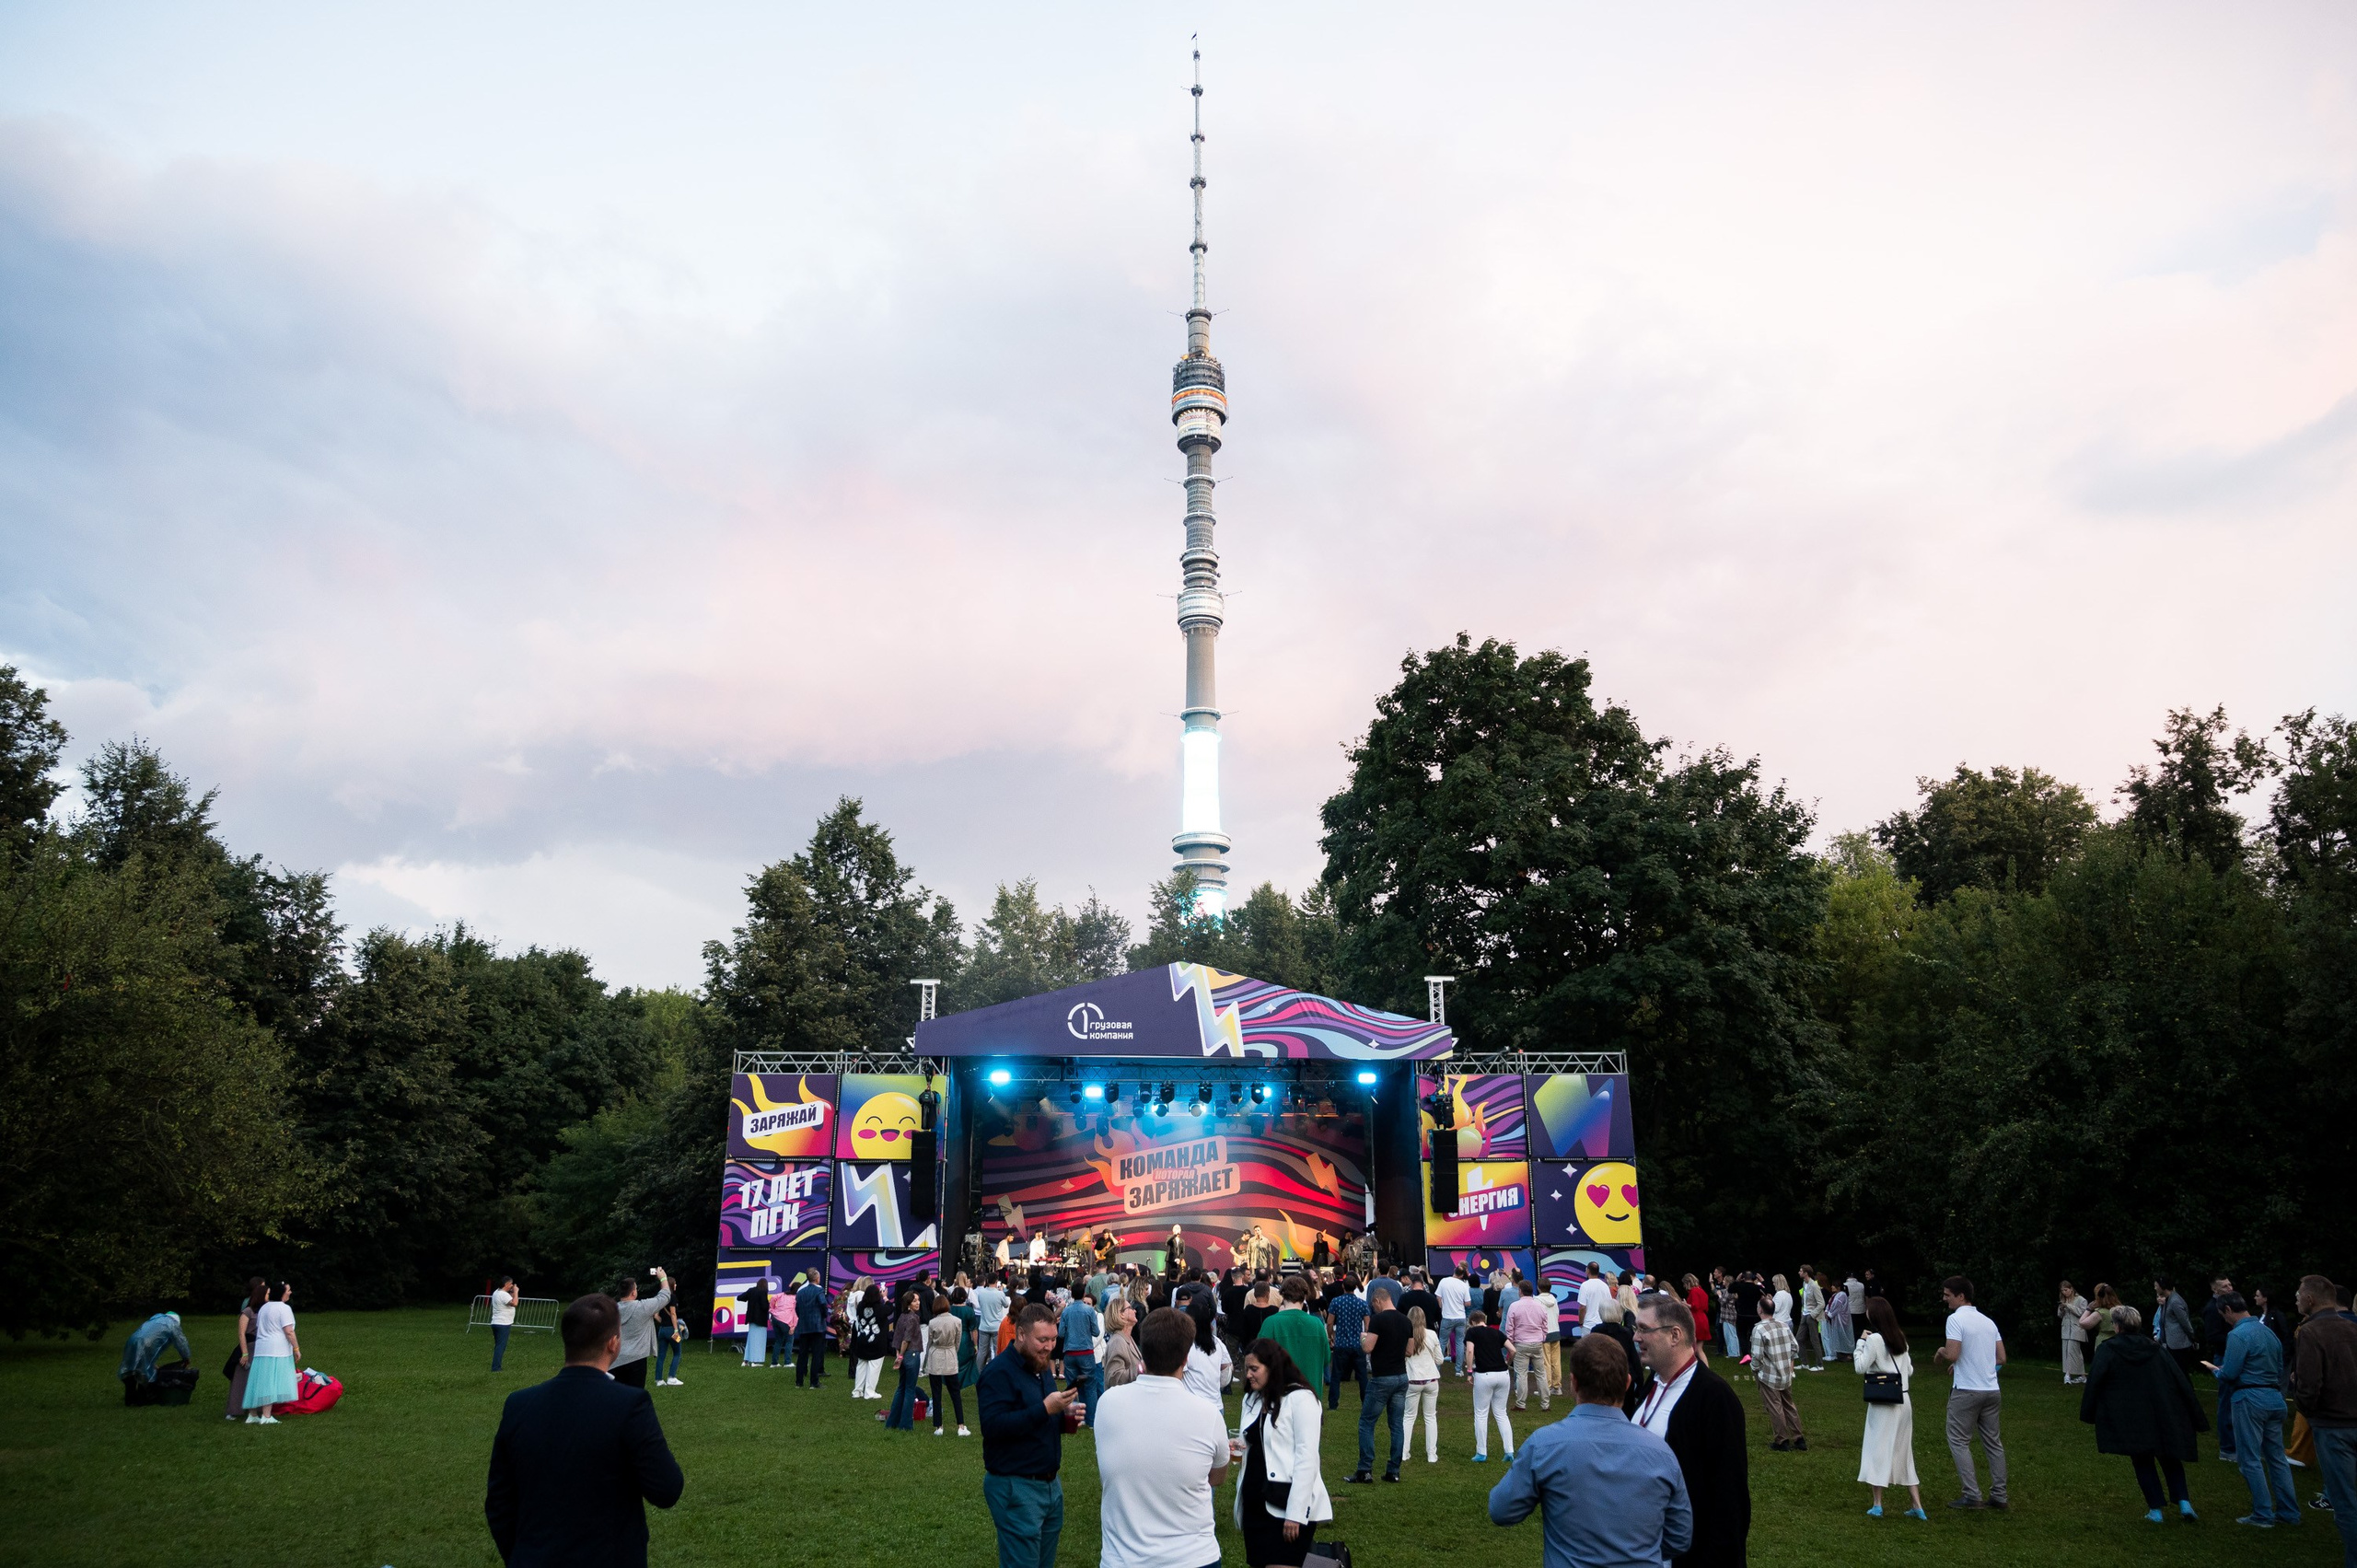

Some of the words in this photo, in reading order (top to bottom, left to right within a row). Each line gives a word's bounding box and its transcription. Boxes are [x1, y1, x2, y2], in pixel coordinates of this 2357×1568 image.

[1090, 1022, 1132, 1030] грузовая
[750, 1104, 818, 1133] ЗАРЯЖАЙ
[1120, 1141, 1219, 1180] КОМАНДА
[1155, 1169, 1195, 1179] КОТОРАЯ
[738, 1179, 764, 1209] 17
[767, 1167, 818, 1204] ЛЕТ
[1129, 1167, 1233, 1209] ЗАРЯЖАЕТ
[1448, 1187, 1518, 1218] НЕРГИЯ
[749, 1202, 800, 1238] ПГК
